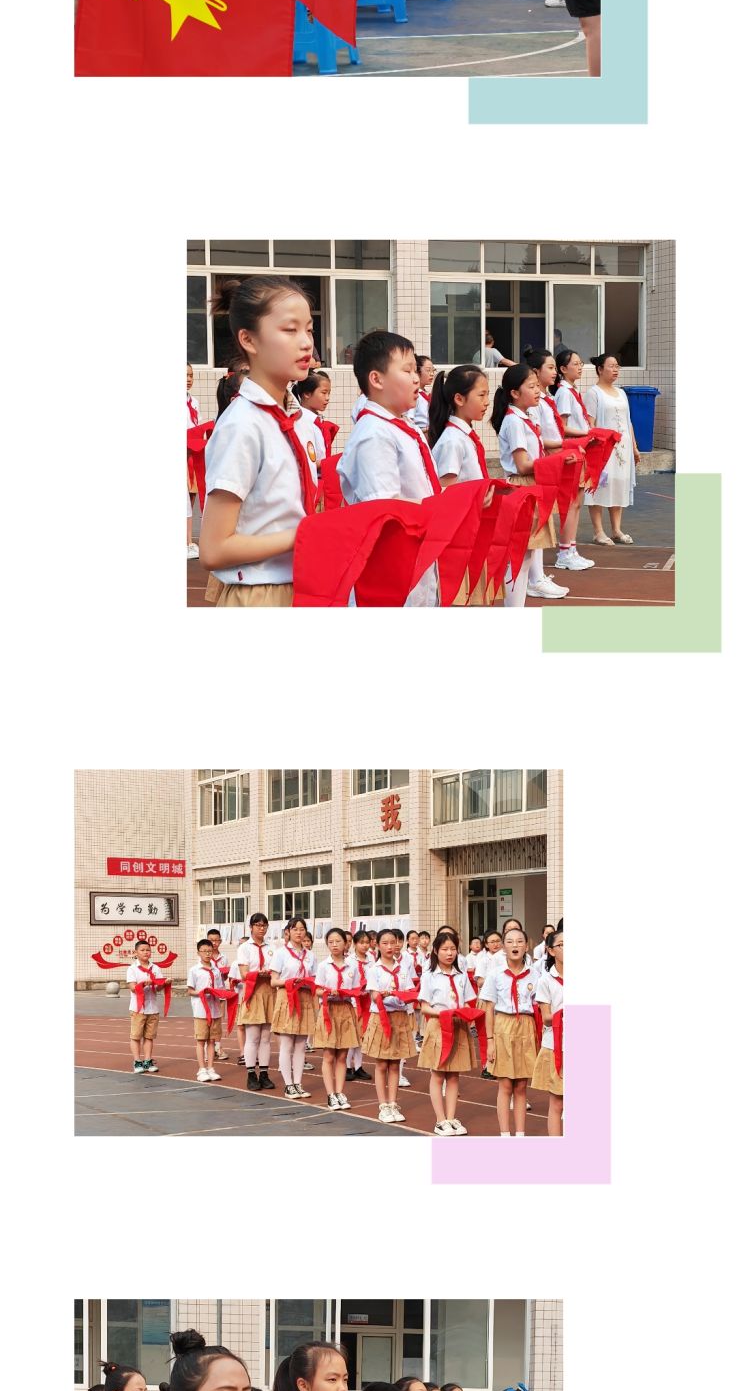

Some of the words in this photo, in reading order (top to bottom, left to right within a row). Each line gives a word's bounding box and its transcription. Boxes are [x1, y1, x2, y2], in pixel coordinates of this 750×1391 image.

[380, 793, 402, 832] 我
[120, 861, 184, 875] 同创文明城
